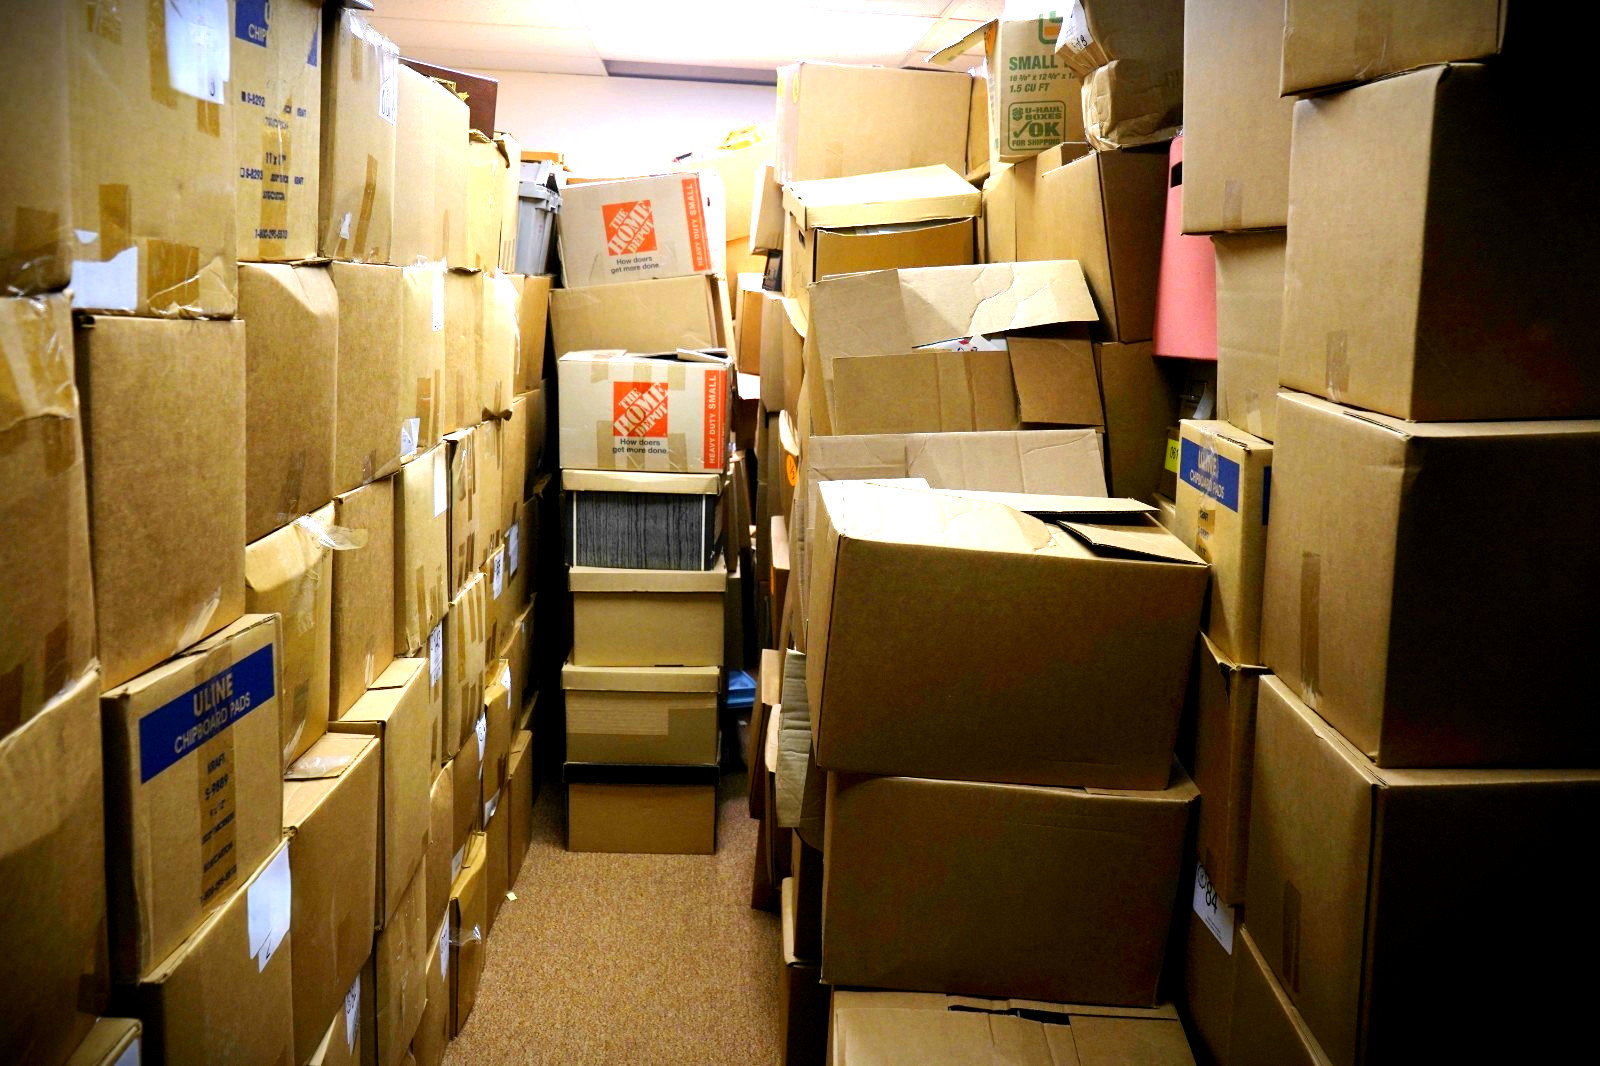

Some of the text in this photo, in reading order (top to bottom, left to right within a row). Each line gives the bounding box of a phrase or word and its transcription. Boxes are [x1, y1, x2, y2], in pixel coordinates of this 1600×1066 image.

[1008, 55, 1058, 71] SMALL
[1010, 82, 1050, 93] 1.5 CU FT
[1028, 121, 1060, 137] OK
[1011, 137, 1060, 147] FOR SHIPPING
[607, 200, 652, 256] HOME
[610, 208, 628, 230] THE
[688, 183, 703, 266] HEAVY DUTY SMALL
[627, 219, 655, 254] DEPOT
[610, 266, 622, 274] get
[623, 264, 641, 272] more
[616, 256, 653, 265] How doers
[613, 382, 669, 437] HOME
[618, 388, 642, 410] THE
[635, 401, 668, 437] DEPOT
[708, 375, 717, 465] HEAVY DUTY SMALL
[612, 446, 626, 455] get
[627, 447, 647, 455] more
[620, 438, 661, 447] How doers
[193, 673, 234, 717] ULINE
[174, 692, 251, 755] CHIPBOARD PADS
